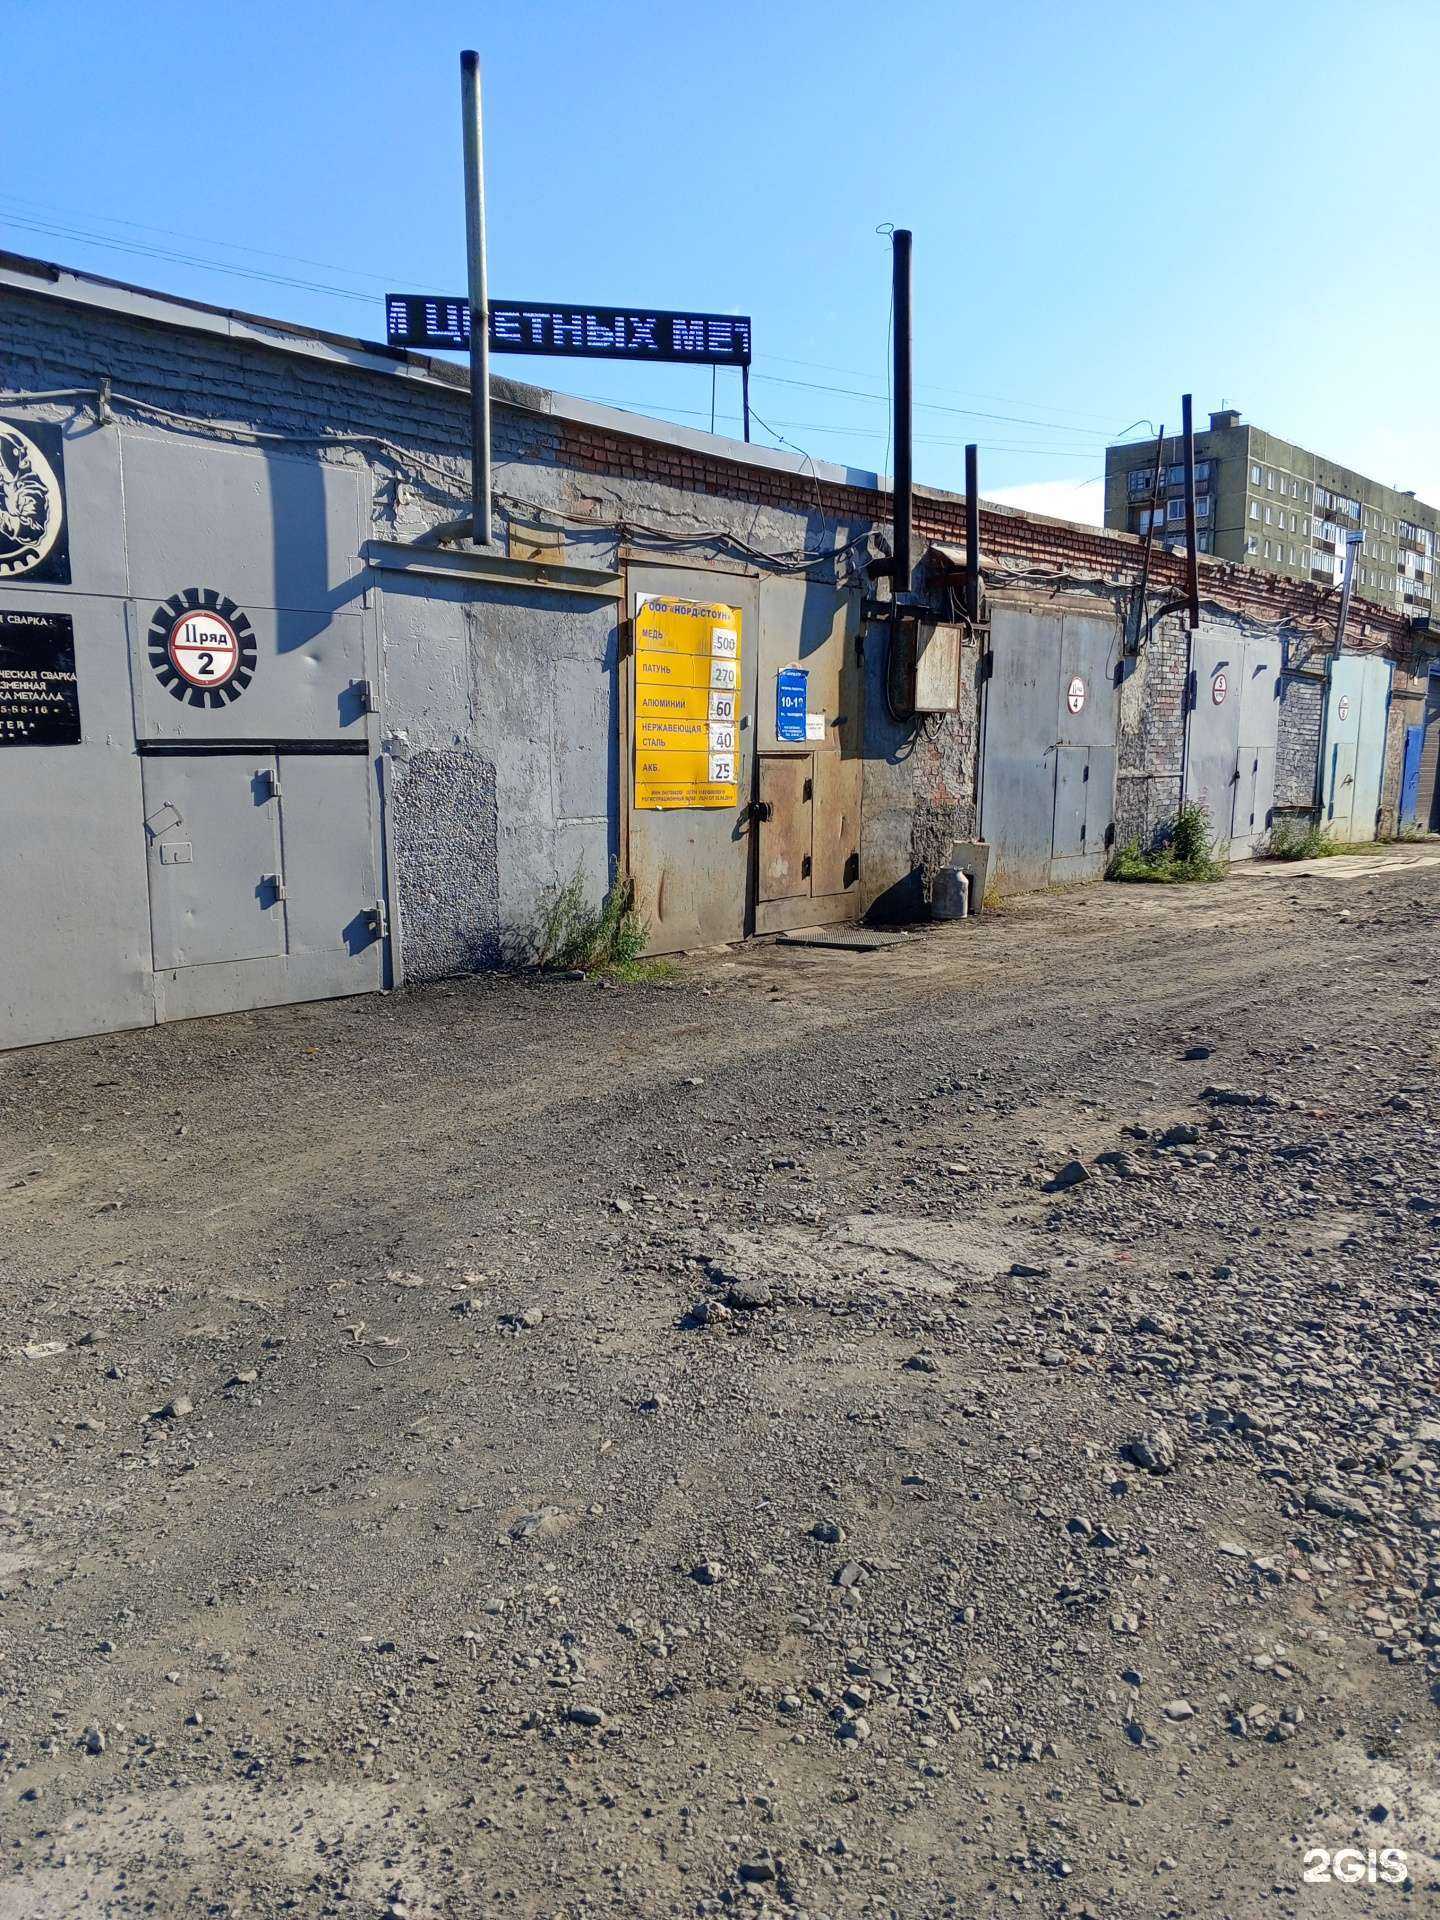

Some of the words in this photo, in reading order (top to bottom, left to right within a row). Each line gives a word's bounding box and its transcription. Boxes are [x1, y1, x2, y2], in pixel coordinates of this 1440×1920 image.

[649, 602, 667, 612] ООО
[642, 628, 663, 639] МЕДЬ
[716, 636, 735, 651] 500
[198, 652, 214, 675] 2
[715, 668, 735, 682] 270
[716, 701, 731, 716] 60
[642, 737, 666, 747] СТАЛЬ
[716, 733, 732, 748] 40
[642, 763, 658, 772] АКБ
[715, 764, 730, 779] 25
